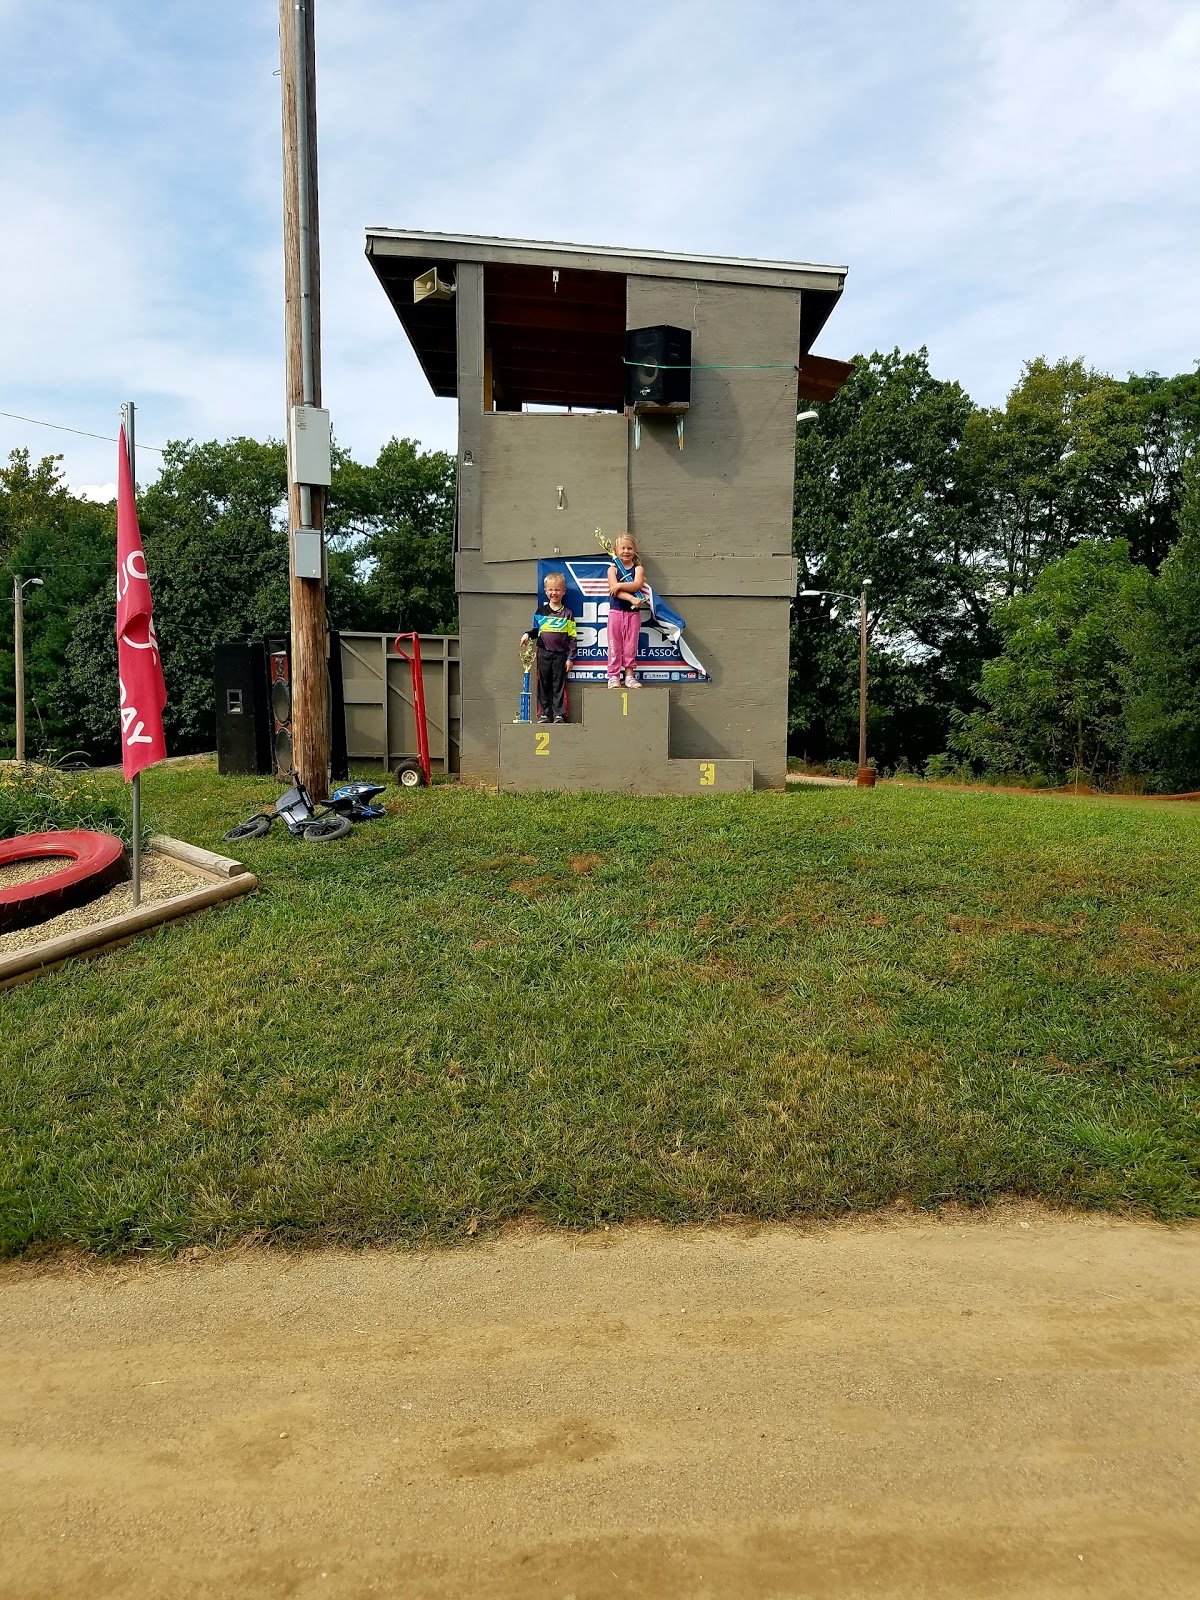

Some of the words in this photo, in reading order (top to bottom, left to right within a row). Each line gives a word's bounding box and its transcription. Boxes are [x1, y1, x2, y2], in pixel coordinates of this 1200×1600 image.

[577, 648, 609, 657] ERICAN
[621, 692, 628, 715] 1
[535, 732, 550, 756] 2
[700, 763, 715, 786] 3
